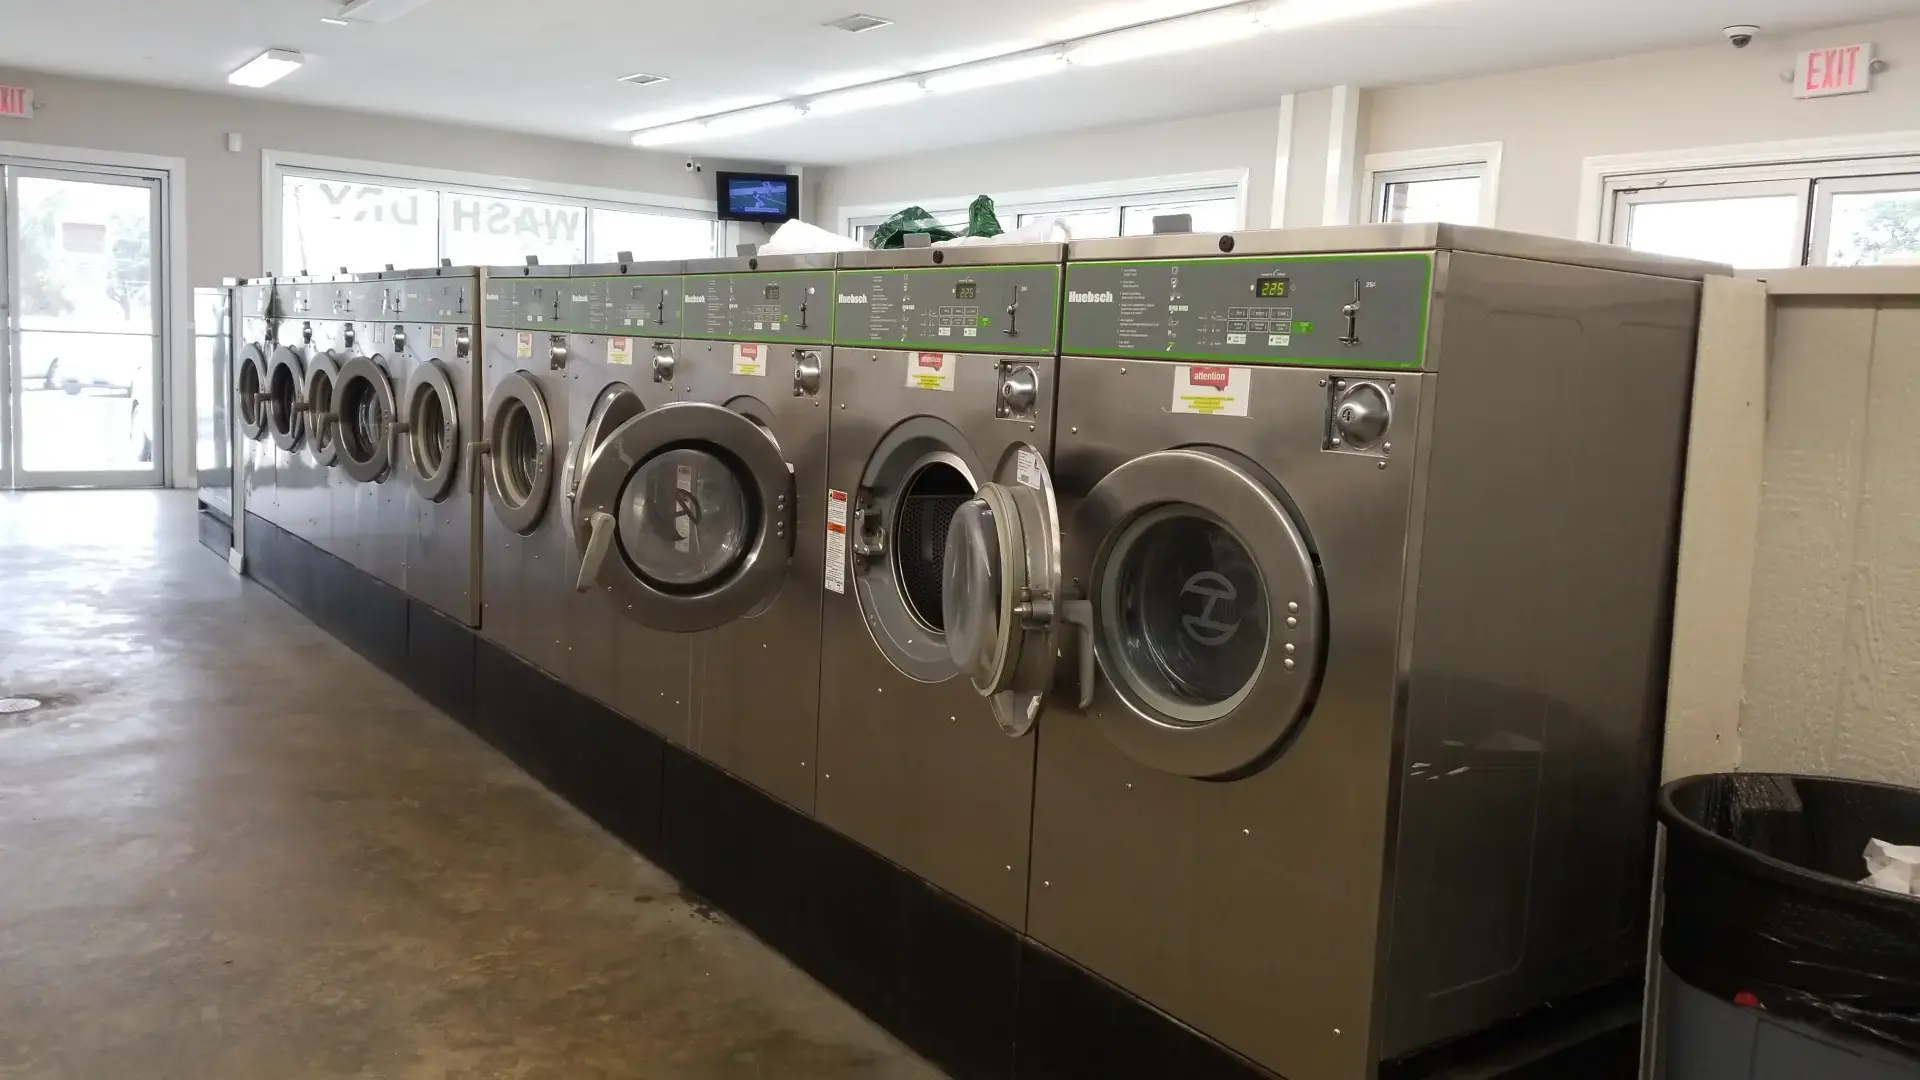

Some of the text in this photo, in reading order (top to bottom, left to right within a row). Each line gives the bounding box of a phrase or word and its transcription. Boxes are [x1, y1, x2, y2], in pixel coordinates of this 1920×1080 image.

[1806, 46, 1860, 90] EXIT
[0, 87, 26, 114] XIT
[1261, 282, 1285, 296] 225
[838, 293, 868, 305] Huebsch
[1068, 290, 1113, 304] Huebsch
[1193, 372, 1226, 381] attention
